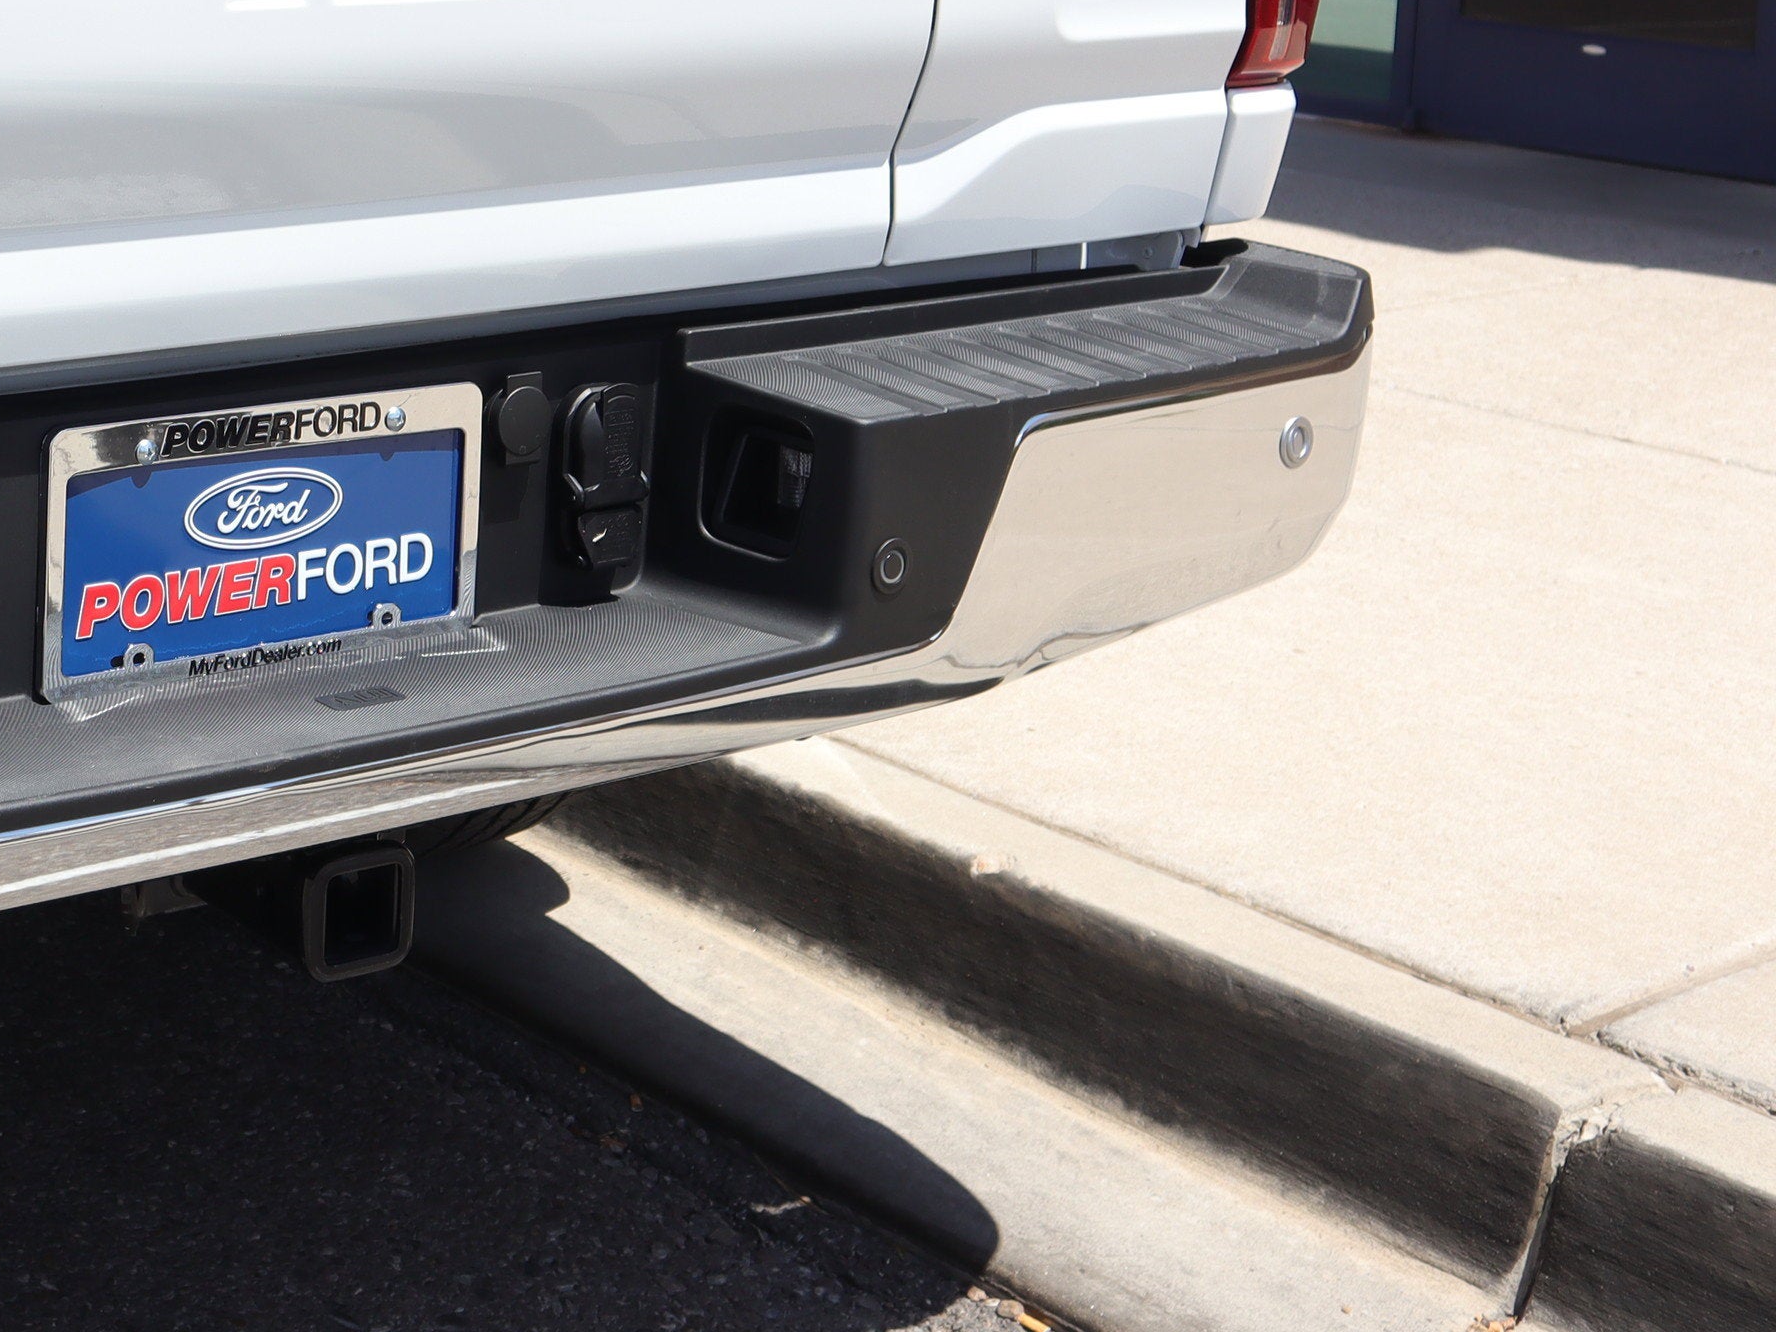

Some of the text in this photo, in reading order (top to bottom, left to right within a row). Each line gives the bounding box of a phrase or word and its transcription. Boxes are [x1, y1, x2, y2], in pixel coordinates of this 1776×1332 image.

[160, 401, 381, 458] POWERFORD
[217, 482, 311, 534] Ford
[75, 533, 434, 640] POWERFORD
[188, 637, 342, 677] MyFordDealer.com
